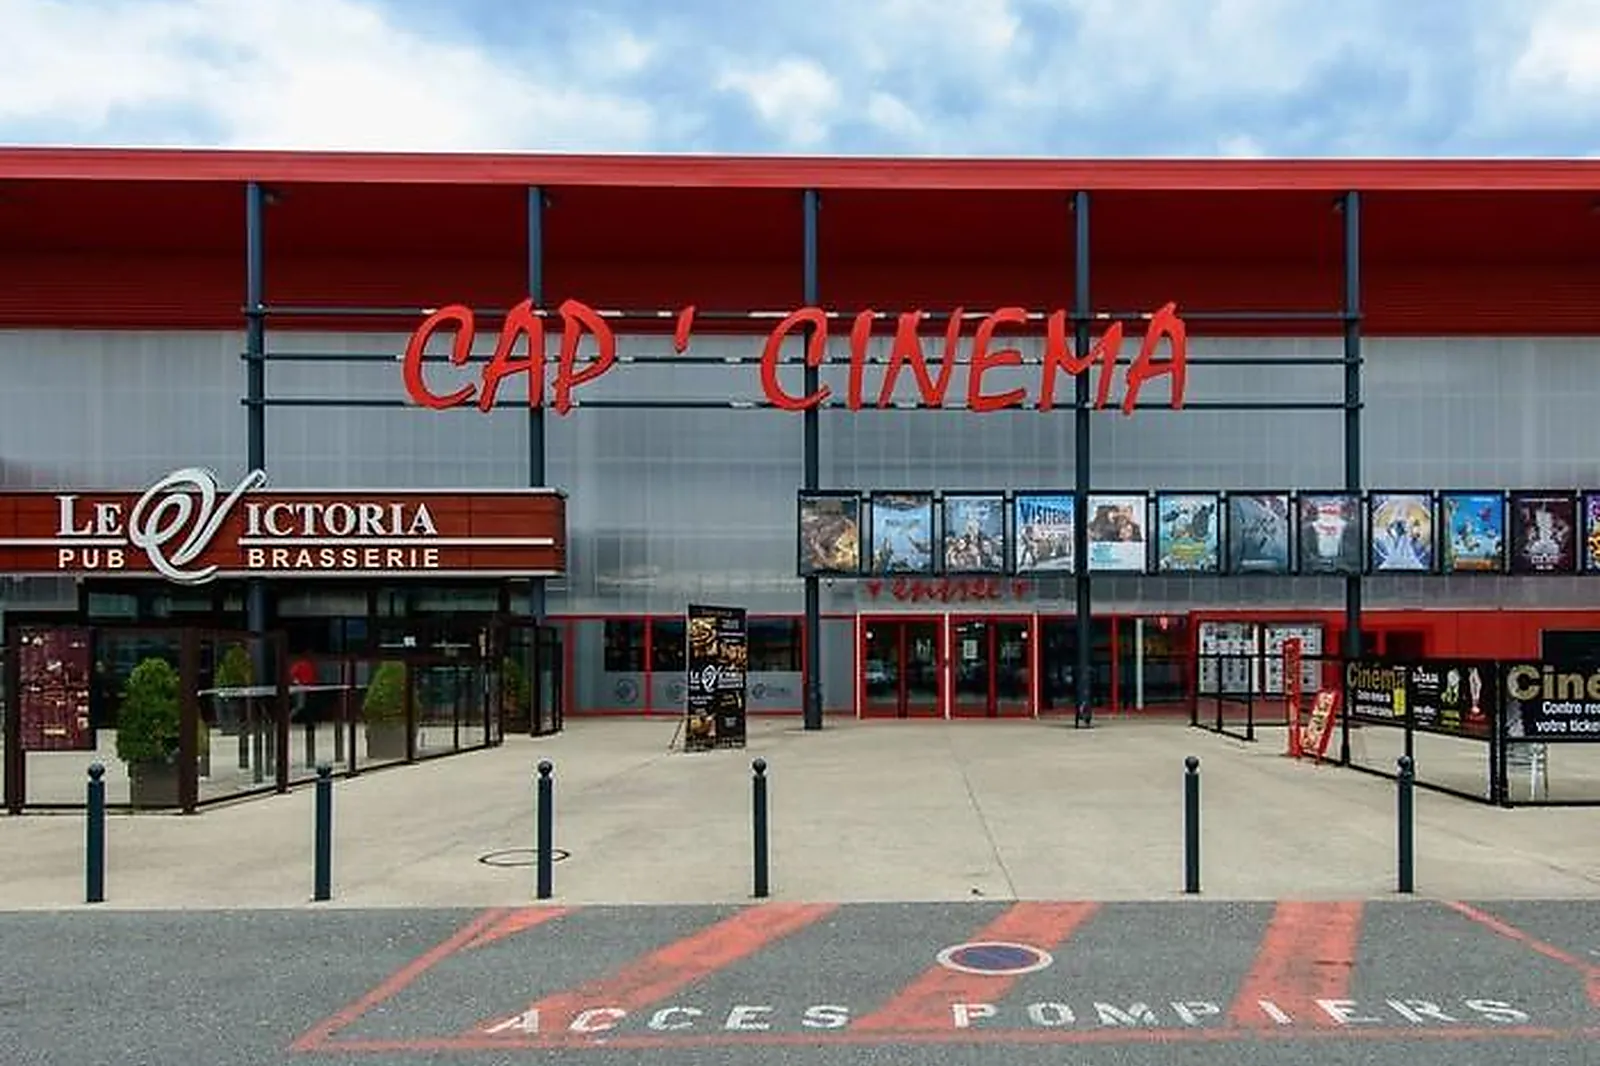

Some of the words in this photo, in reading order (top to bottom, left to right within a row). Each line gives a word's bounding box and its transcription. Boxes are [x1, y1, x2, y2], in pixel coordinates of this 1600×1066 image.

[760, 301, 1187, 414] CINEMA
[58, 549, 126, 569] PUB
[247, 548, 440, 568] BRASSERIE
[483, 1004, 850, 1036] ACCES
[952, 999, 1531, 1028] POMPIERS
